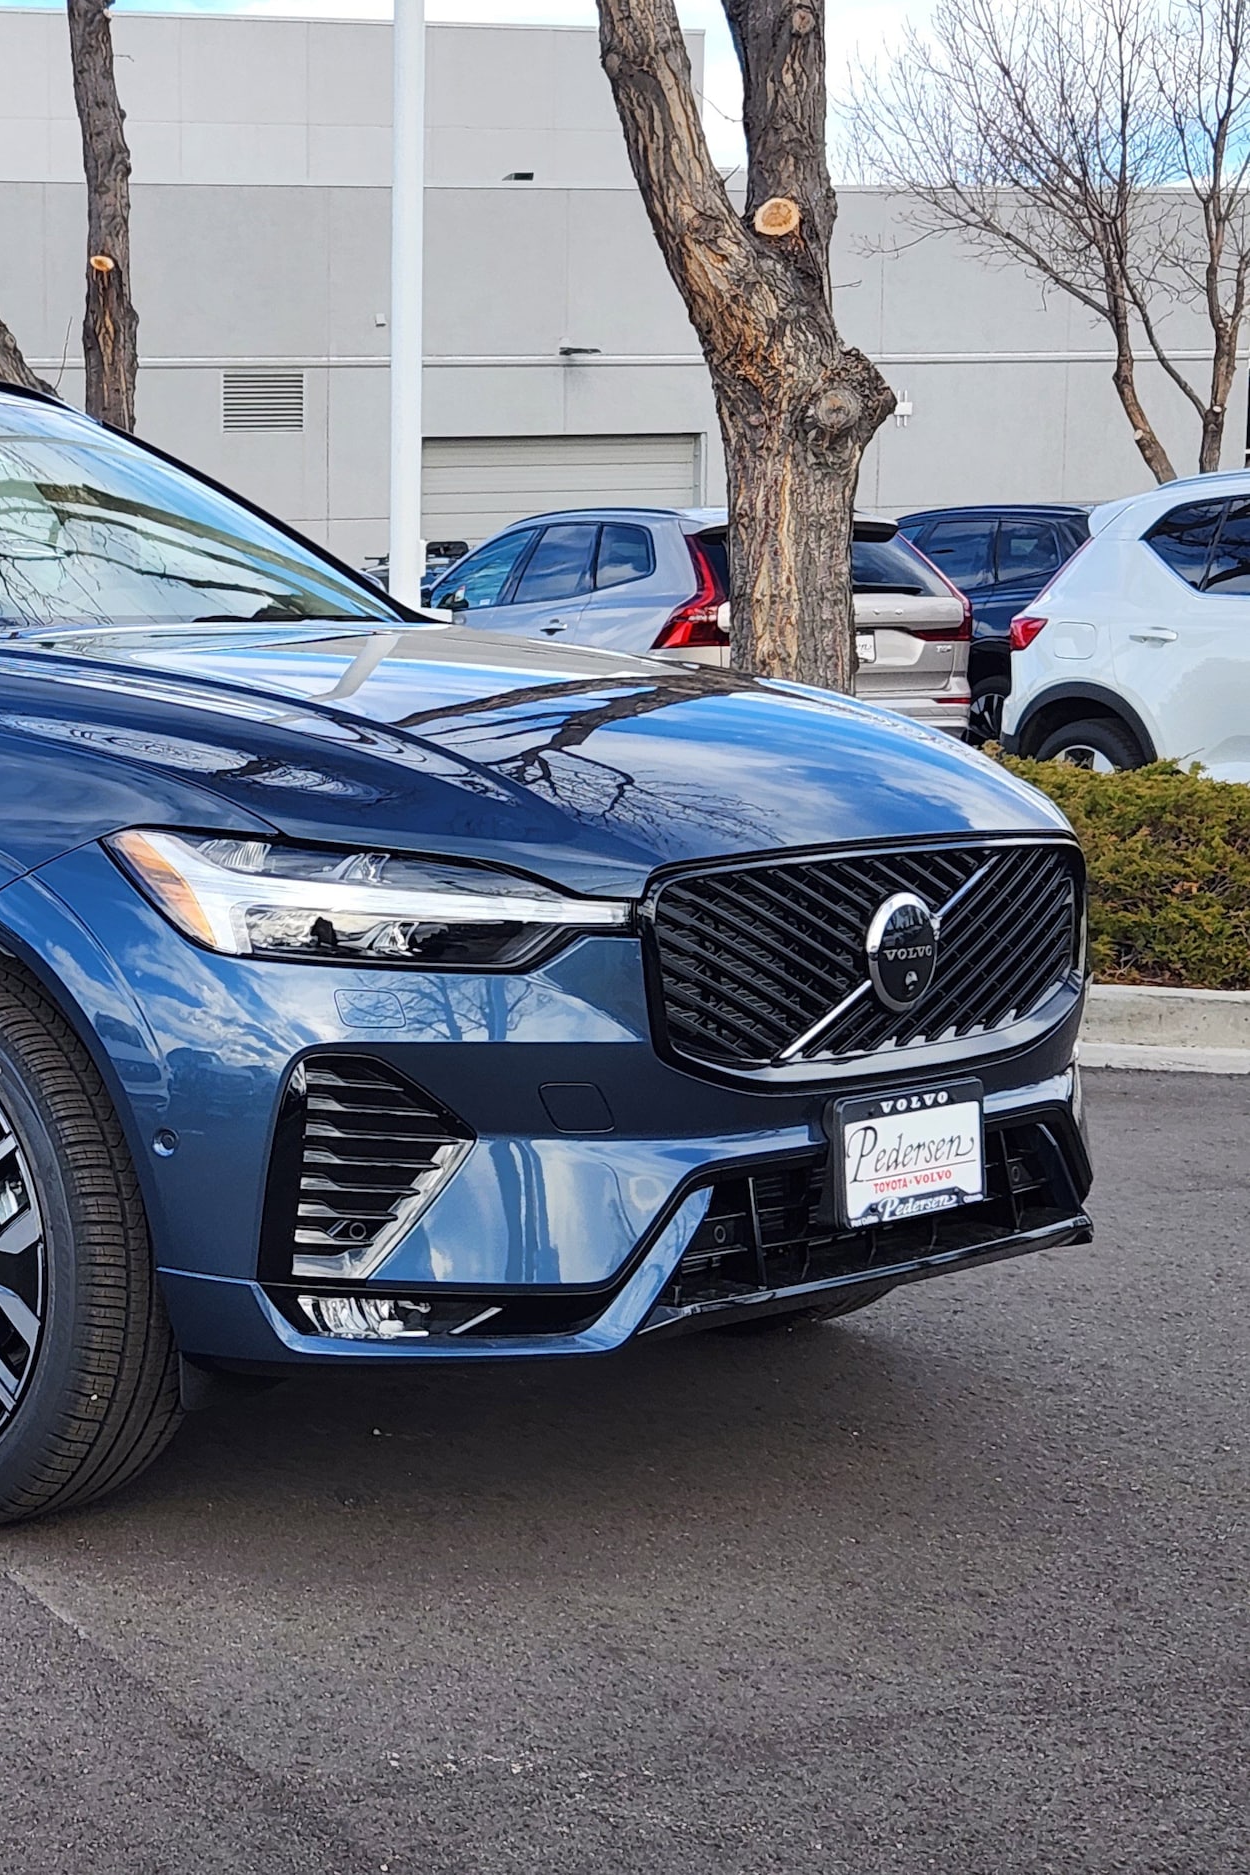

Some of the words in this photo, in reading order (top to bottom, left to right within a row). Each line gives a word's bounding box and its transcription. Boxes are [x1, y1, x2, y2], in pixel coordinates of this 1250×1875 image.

[883, 945, 932, 960] VOLVO
[880, 1091, 949, 1114] VOLVO
[847, 1125, 975, 1184] Pedersen
[878, 1194, 958, 1221] Pedersen
